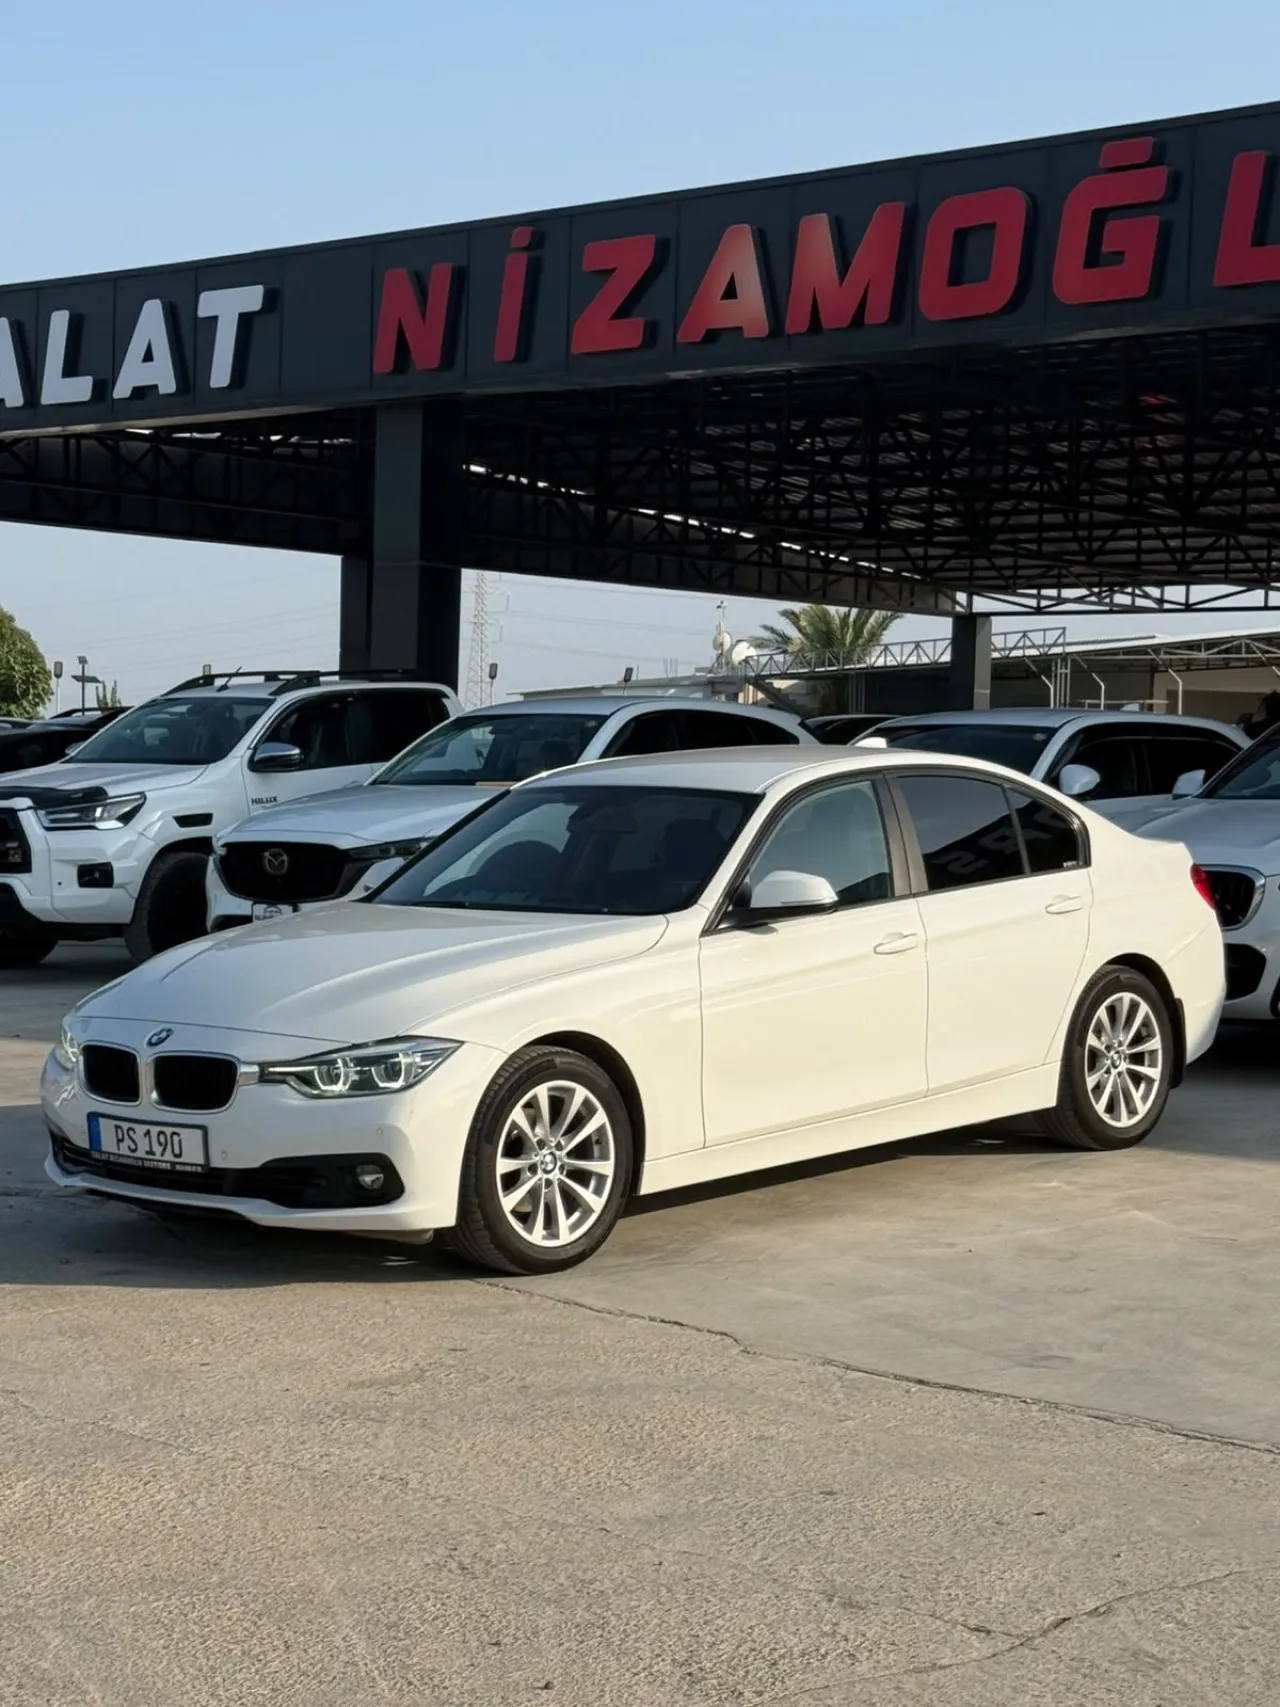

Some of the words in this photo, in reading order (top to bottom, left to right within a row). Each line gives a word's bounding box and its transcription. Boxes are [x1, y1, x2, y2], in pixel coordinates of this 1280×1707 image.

[251, 796, 278, 805] HILUX
[114, 1124, 138, 1153] PS
[143, 1128, 183, 1159] 190
